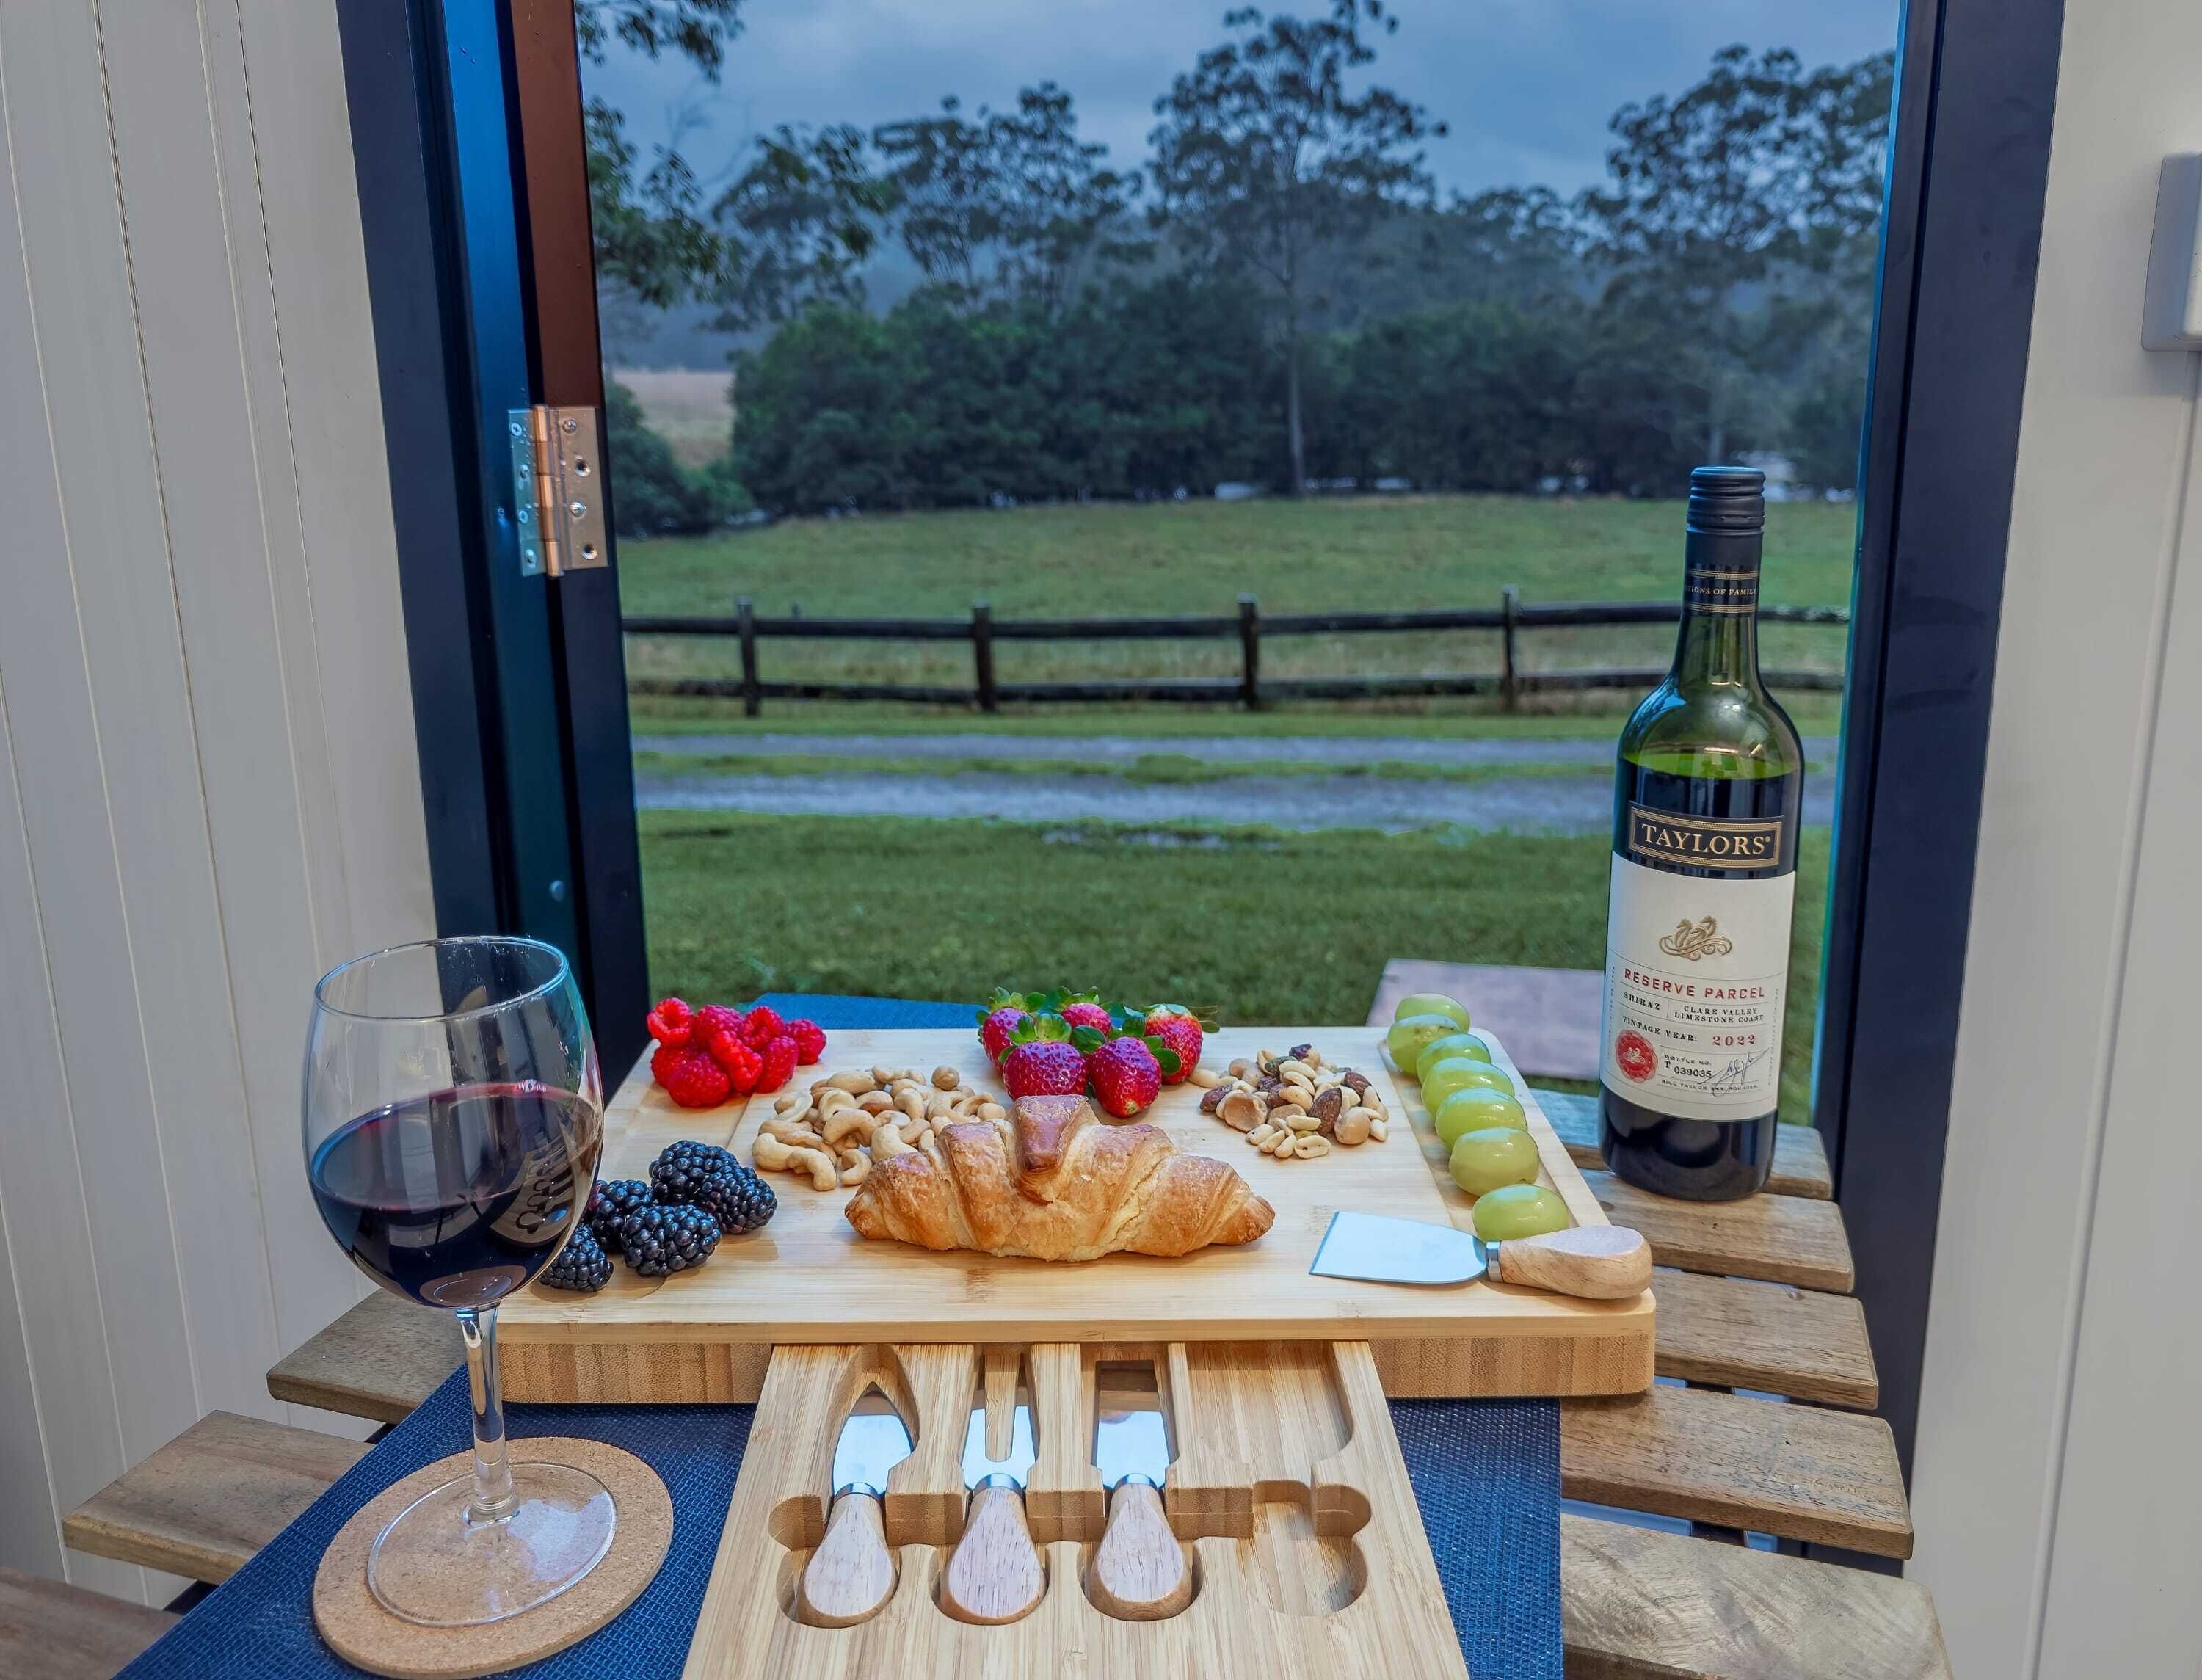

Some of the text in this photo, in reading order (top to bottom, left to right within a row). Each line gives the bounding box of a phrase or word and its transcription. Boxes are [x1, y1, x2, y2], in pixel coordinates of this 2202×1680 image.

[1624, 968, 1765, 1000] RESERVE PARCEL
[1624, 992, 1660, 1010] SHIRAZ
[1684, 1006, 1757, 1016] CLARE VALLEY
[1674, 1011, 1764, 1023] LIMESTONE COAST
[1622, 1016, 1660, 1035] VINTAGE
[1712, 1035, 1756, 1046] 2022
[1664, 1061, 1671, 1069] T
[1665, 1055, 1695, 1064] BOTTLE
